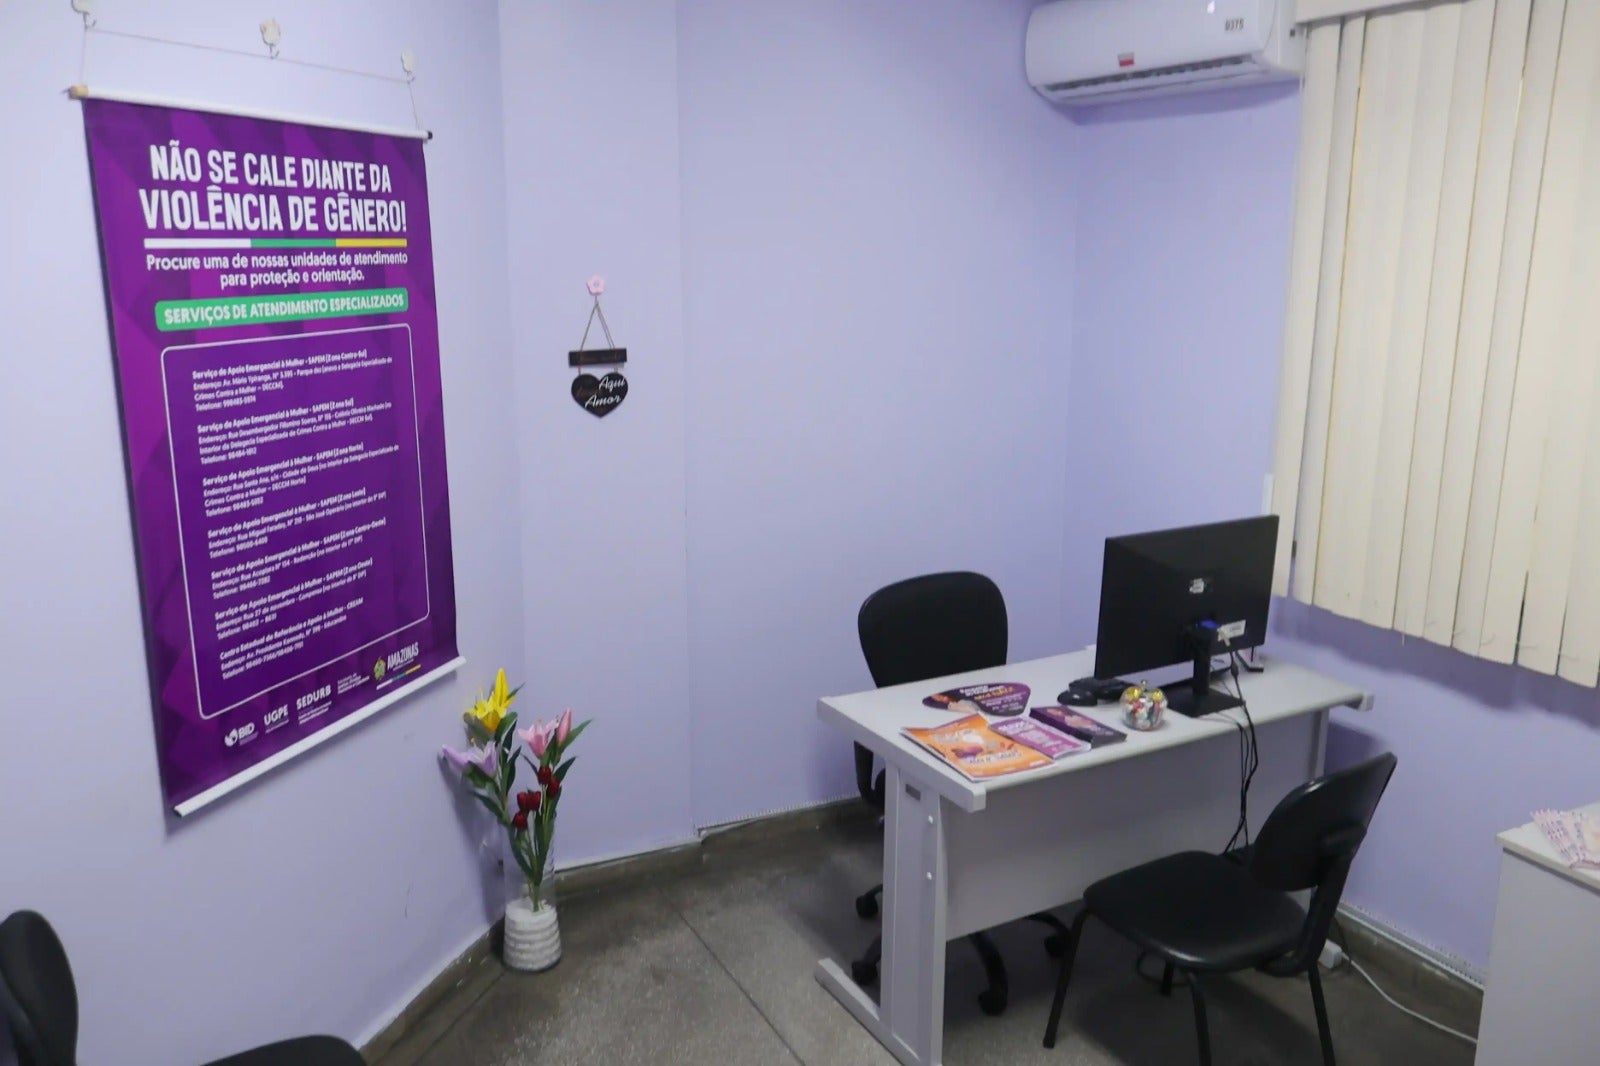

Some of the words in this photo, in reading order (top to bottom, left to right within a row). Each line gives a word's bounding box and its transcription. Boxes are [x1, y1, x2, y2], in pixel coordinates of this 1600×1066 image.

[150, 140, 202, 182] NÃO
[208, 150, 238, 184] SE
[243, 152, 298, 188] CALE
[301, 158, 366, 192] DIANTE
[370, 164, 392, 193] DA
[139, 185, 284, 230] VIOLÊNCIA
[288, 195, 320, 231] DE
[324, 192, 406, 232] GÊNERO!
[146, 254, 200, 271] Procure
[203, 256, 229, 269] uma
[232, 252, 248, 269] de
[251, 256, 289, 268] nossas
[291, 252, 337, 266] unidades
[339, 252, 352, 266] de
[354, 251, 408, 265] atendimento
[220, 274, 247, 290] para
[250, 269, 300, 288] proteção
[302, 272, 309, 283] e
[311, 267, 364, 284] orientação.
[164, 306, 230, 326] SERVIÇOS
[232, 304, 248, 319] DE
[250, 300, 328, 318] ATENDIMENTO
[330, 294, 403, 312] ESPECIALIZADOS
[599, 376, 625, 391] Aqui
[585, 395, 621, 408] Amor
[388, 642, 418, 670] AMAZONAS
[296, 684, 331, 710] SEDURB
[264, 704, 288, 726] UGPE
[238, 722, 255, 739] BID
